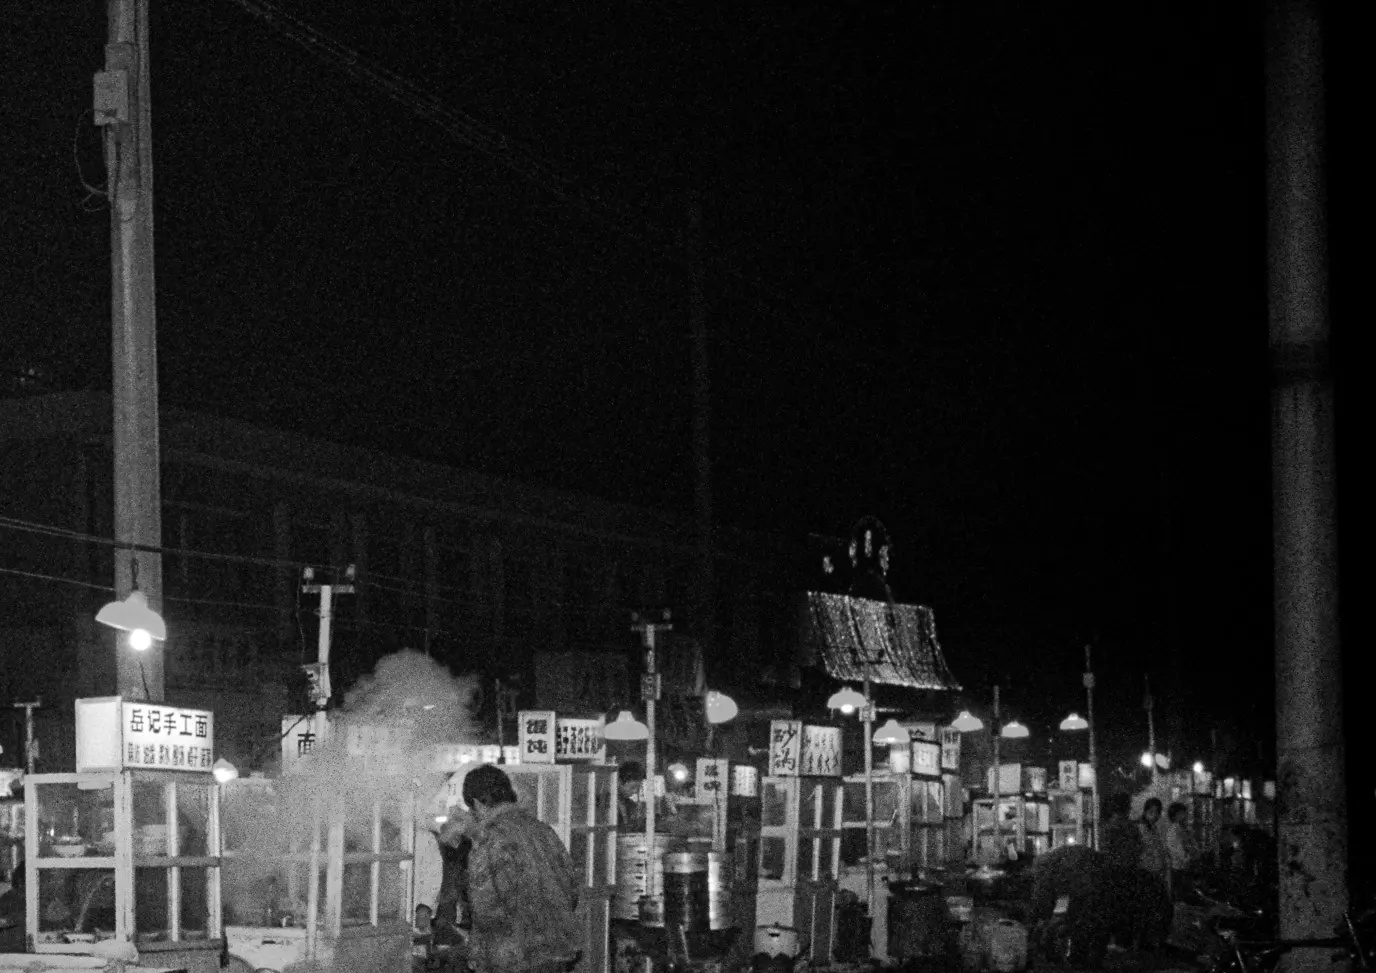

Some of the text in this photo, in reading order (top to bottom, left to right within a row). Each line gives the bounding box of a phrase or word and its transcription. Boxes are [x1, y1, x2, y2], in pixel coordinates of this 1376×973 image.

[130, 708, 208, 738] 岳记手工面
